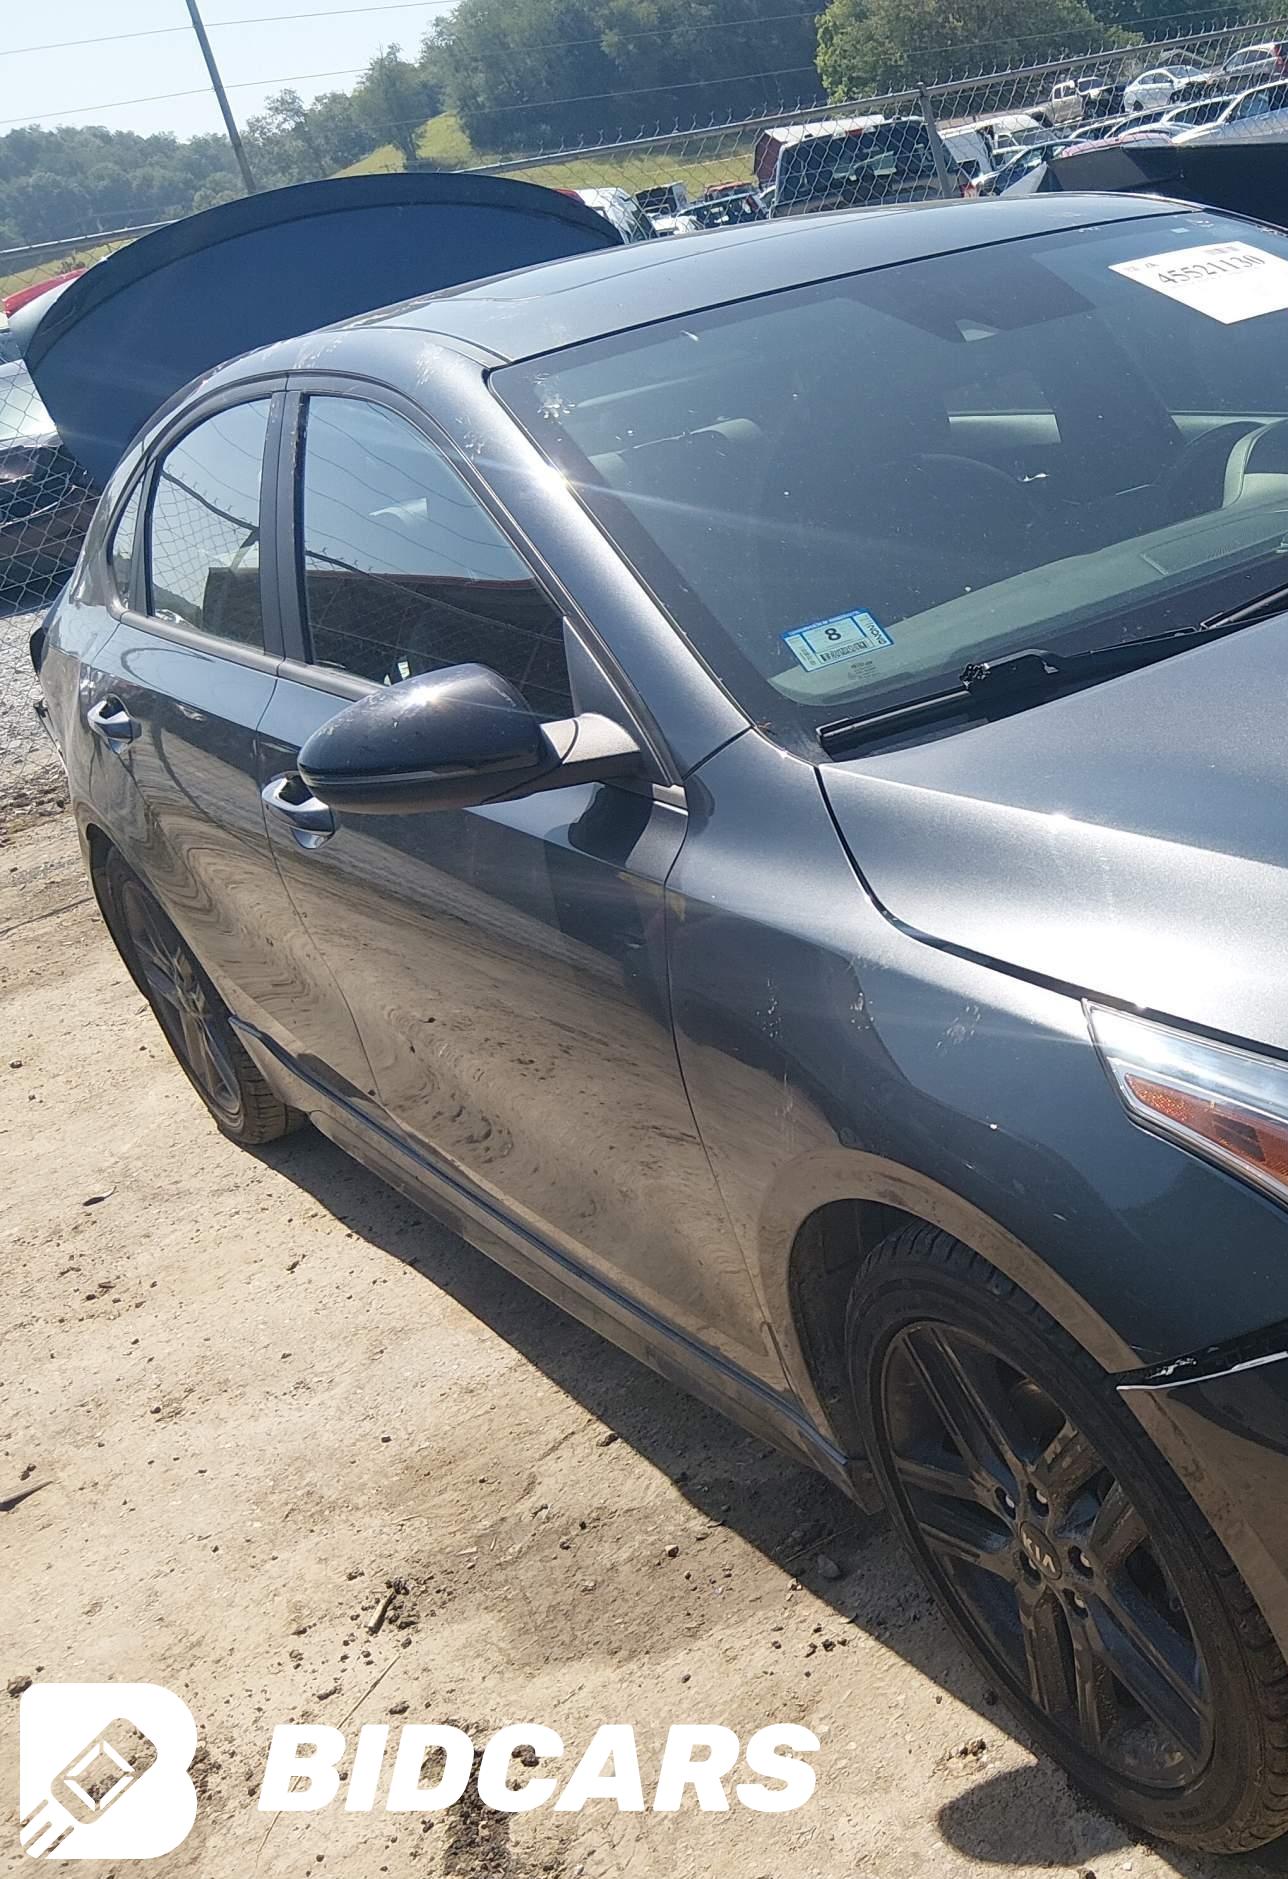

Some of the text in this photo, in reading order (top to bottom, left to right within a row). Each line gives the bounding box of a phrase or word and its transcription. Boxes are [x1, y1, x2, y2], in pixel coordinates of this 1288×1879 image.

[1158, 255, 1265, 283] 45521130
[825, 628, 842, 641] 8
[1022, 1531, 1056, 1573] KIA
